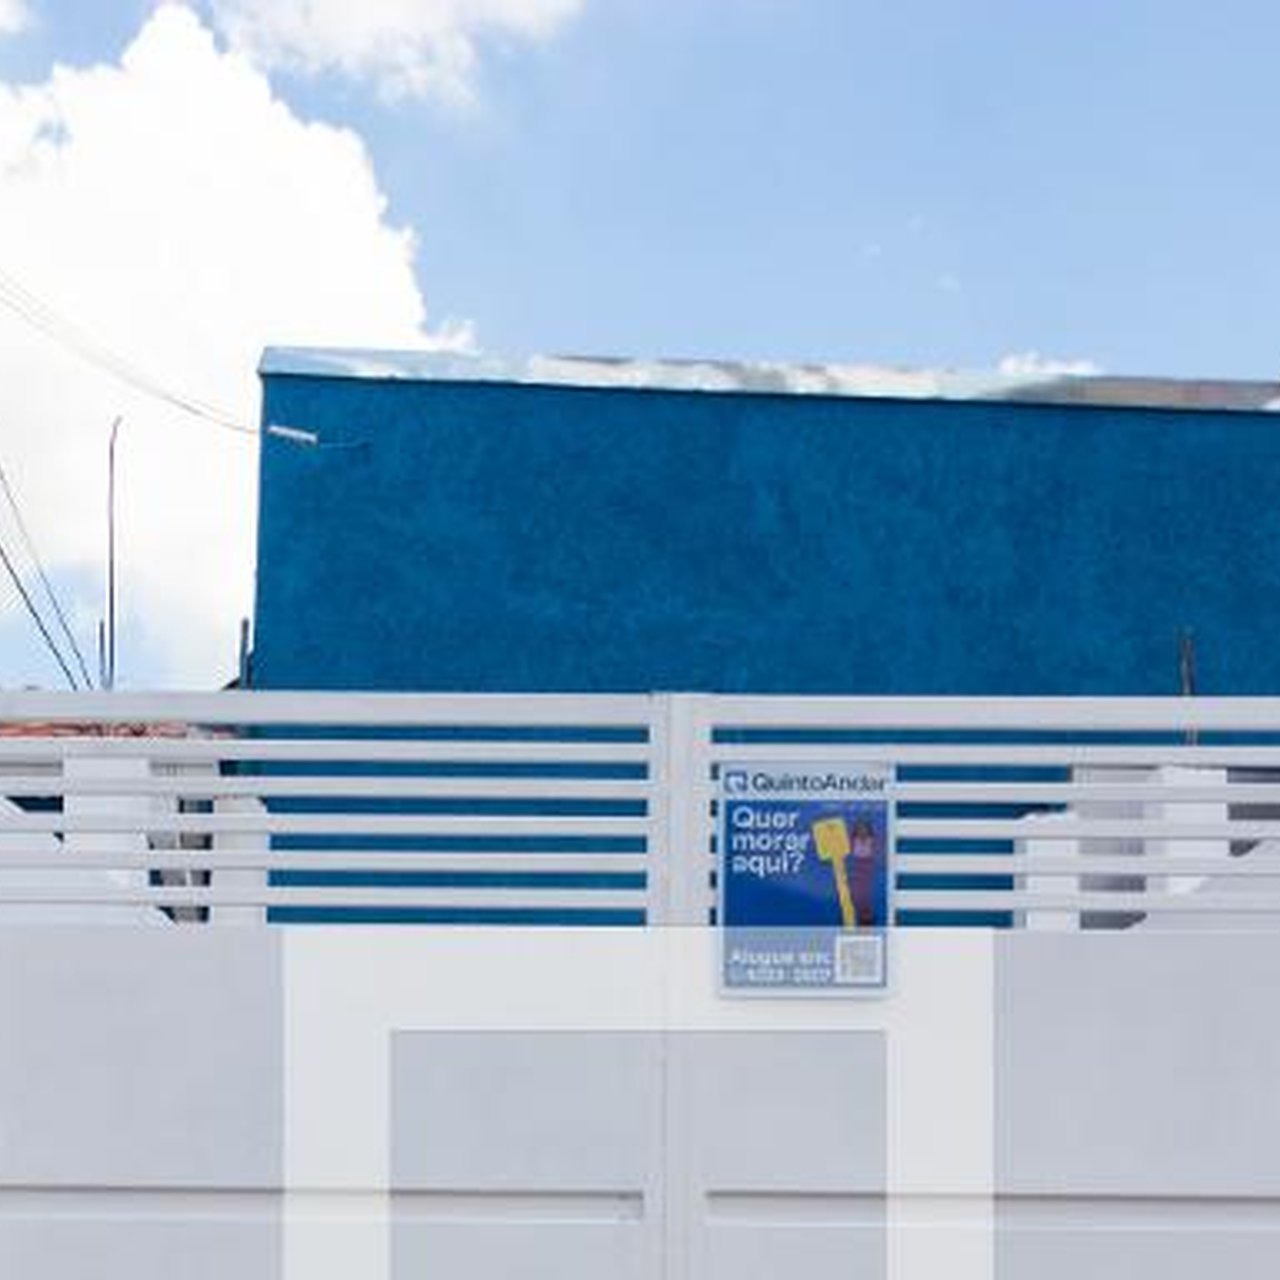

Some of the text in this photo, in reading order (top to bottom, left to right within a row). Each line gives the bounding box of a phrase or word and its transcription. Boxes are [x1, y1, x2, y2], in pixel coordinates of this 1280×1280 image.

[751, 772, 887, 792] QuintoAndar
[732, 805, 799, 828] Quer
[732, 832, 811, 850] morar
[732, 851, 805, 878] aqui?
